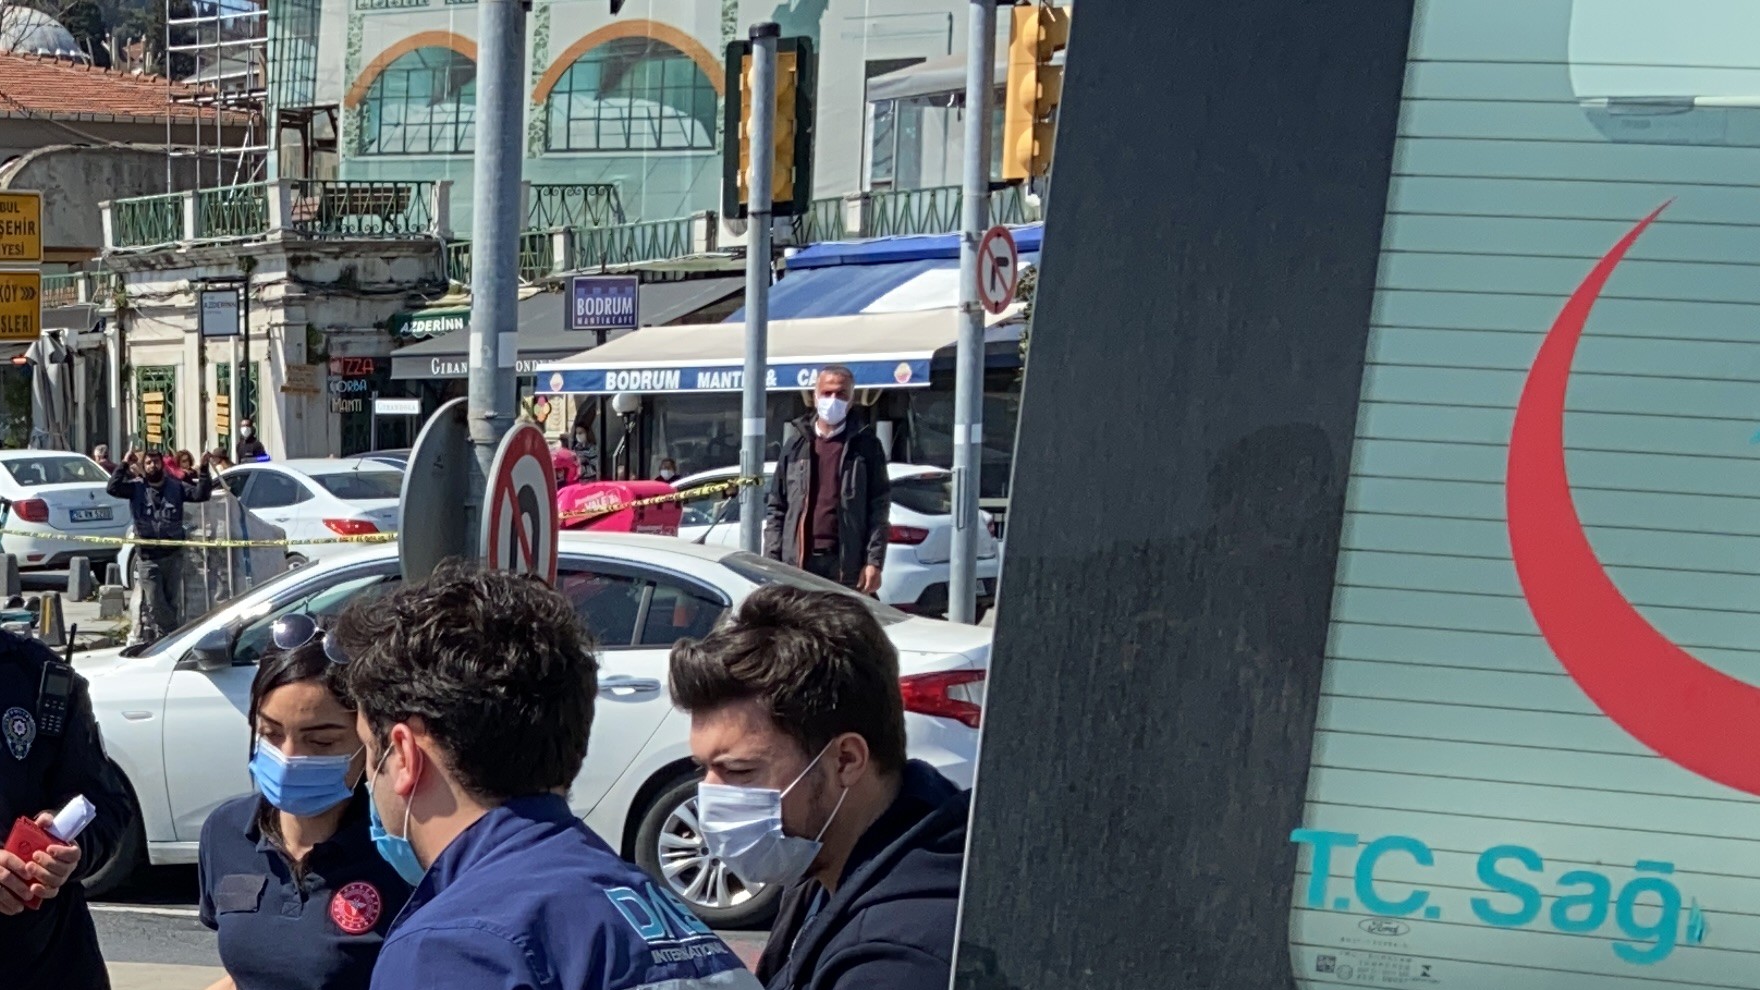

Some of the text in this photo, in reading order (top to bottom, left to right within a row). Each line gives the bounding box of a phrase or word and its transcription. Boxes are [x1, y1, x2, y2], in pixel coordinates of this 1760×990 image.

[577, 297, 633, 316] BODRUM
[400, 316, 463, 333] AZDERİNN
[431, 357, 469, 375] GIRAN
[605, 369, 681, 391] BODRUM
[797, 368, 818, 386] CA
[1290, 828, 1441, 919] T.C.
[604, 881, 716, 940] DAS
